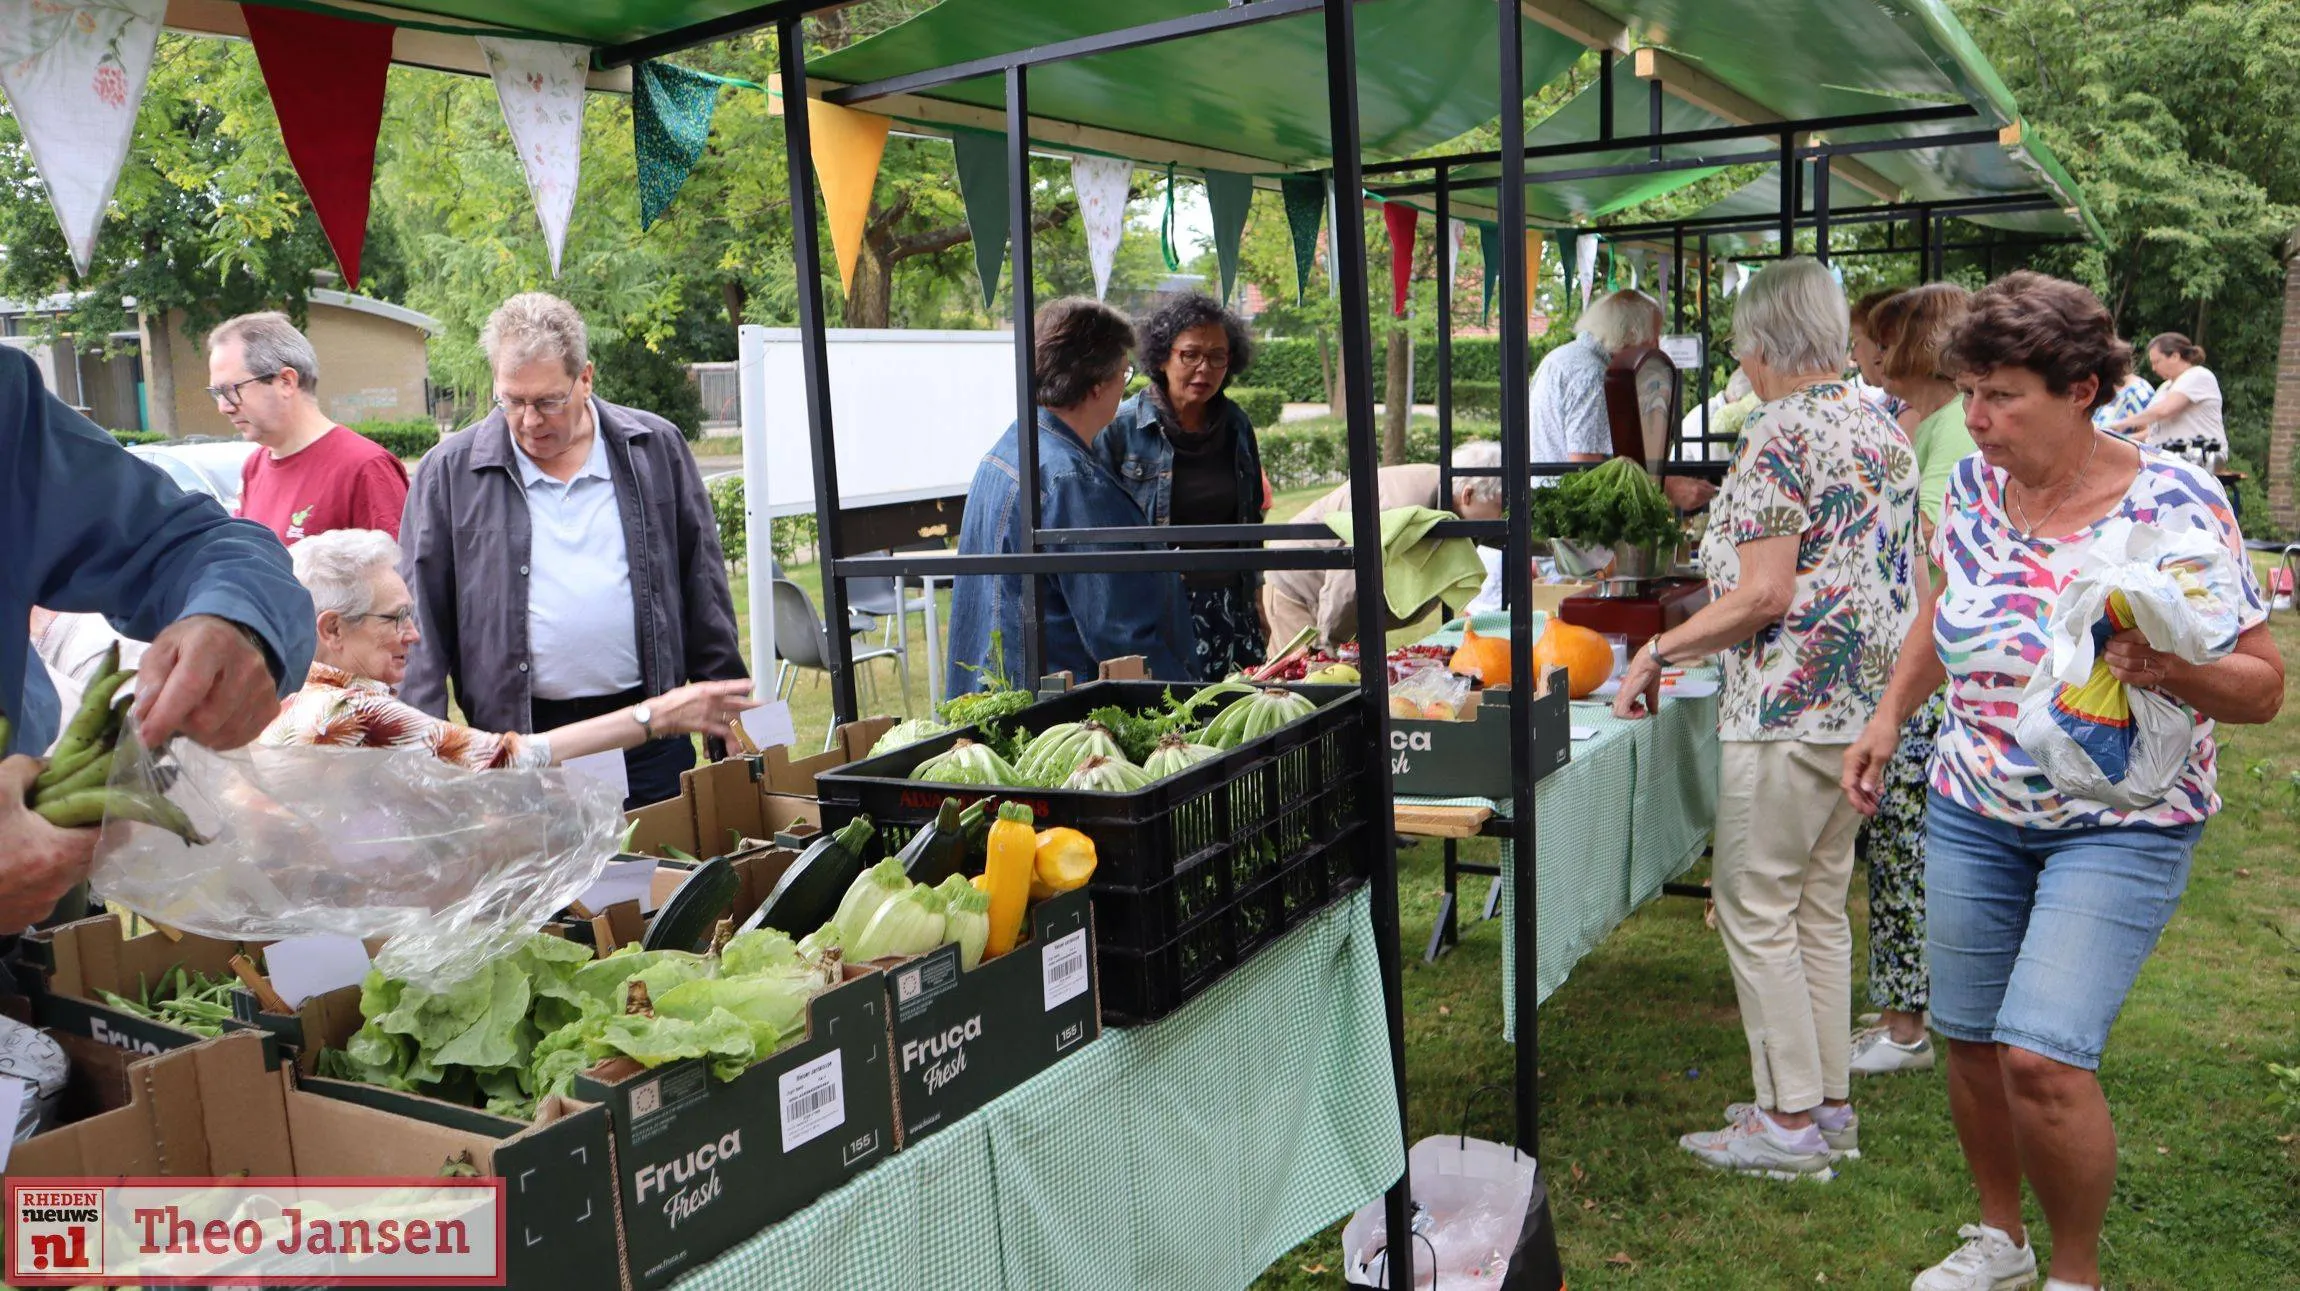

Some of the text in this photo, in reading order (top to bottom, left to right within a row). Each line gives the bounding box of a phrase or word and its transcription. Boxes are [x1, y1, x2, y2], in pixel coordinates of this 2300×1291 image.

[902, 1015, 982, 1074] Fruca
[923, 1046, 968, 1096] Fresh
[635, 1128, 742, 1205] Fruca
[849, 1133, 872, 1154] 155
[663, 1167, 722, 1230] Fresh
